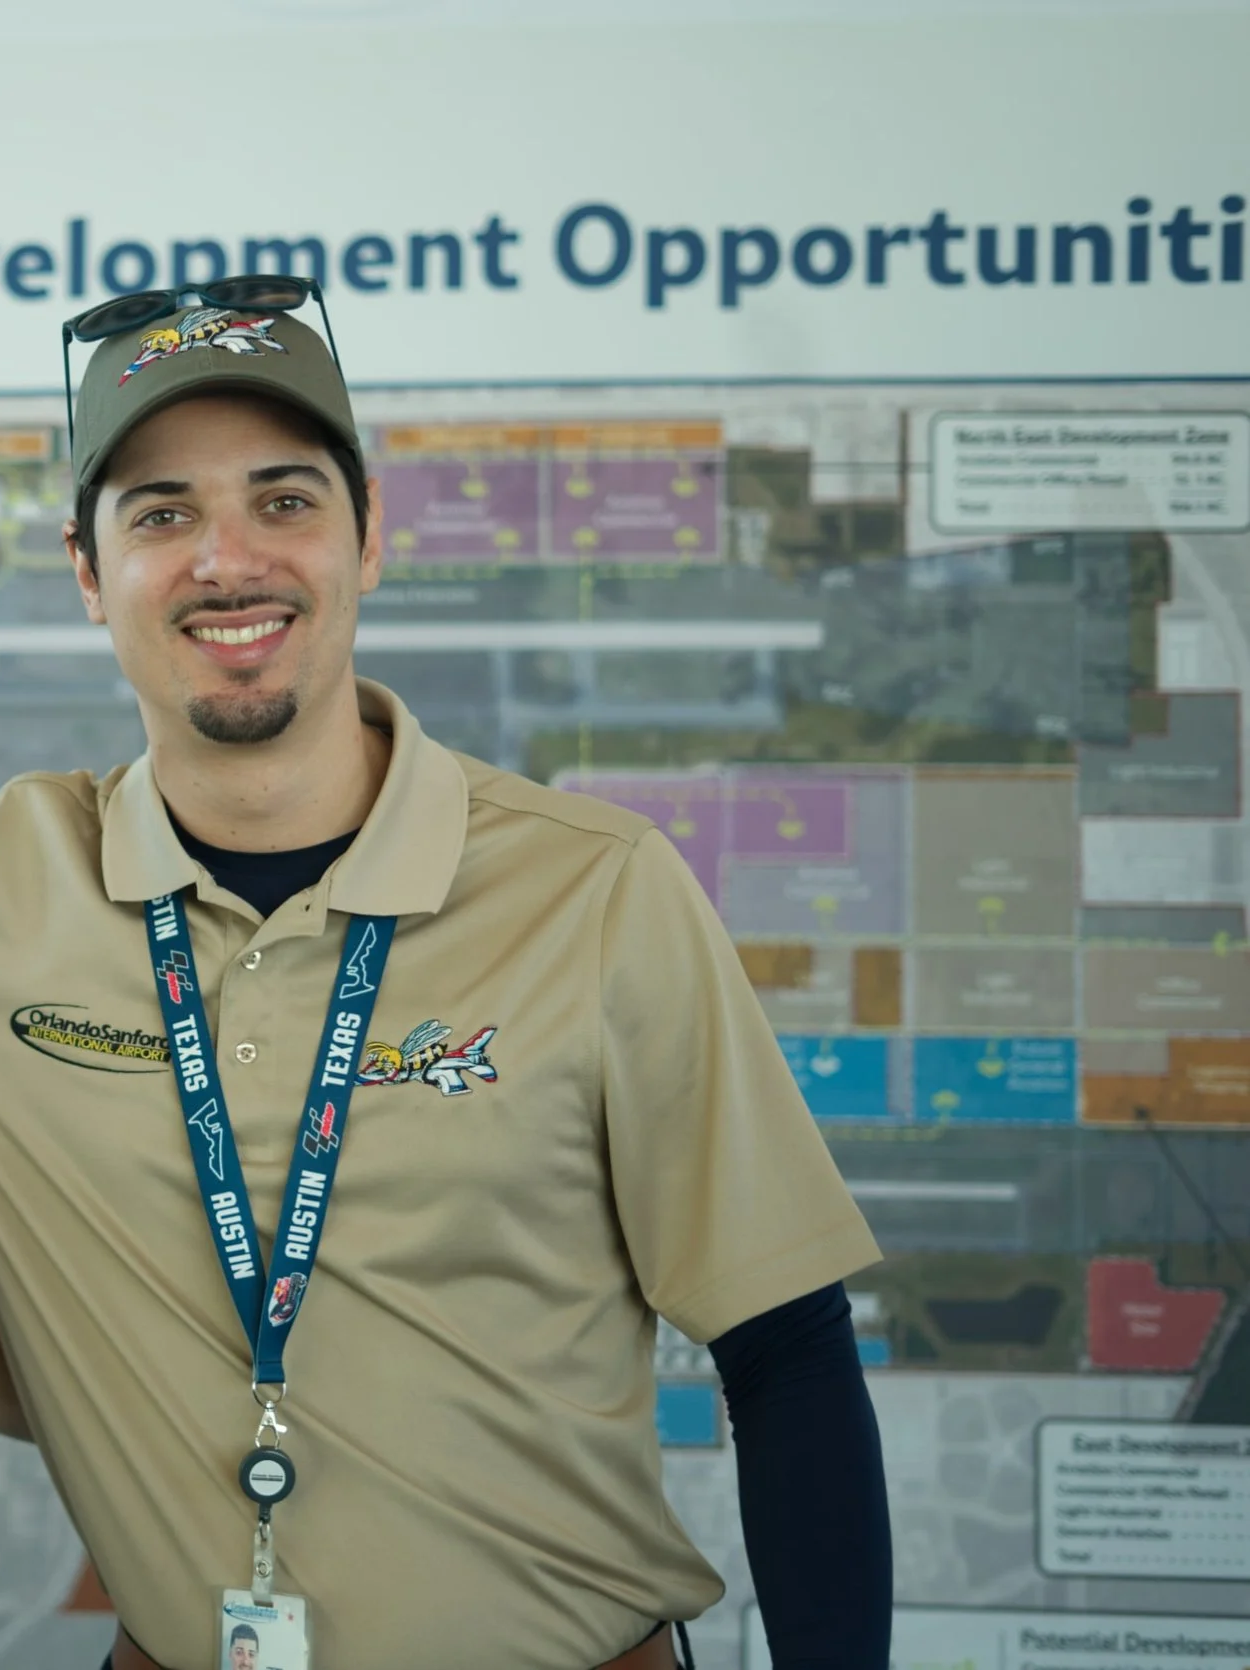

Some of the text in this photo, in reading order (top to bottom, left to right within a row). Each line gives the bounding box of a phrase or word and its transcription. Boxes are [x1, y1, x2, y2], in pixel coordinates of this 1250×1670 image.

[554, 194, 1250, 308] Opportuniti
[28, 1025, 166, 1062] INTERNATIONAL AIRPORT
[172, 1014, 209, 1092] TEXAS
[321, 1011, 362, 1087] TEXAS
[210, 1191, 256, 1280] AUSTIN
[285, 1170, 327, 1260] AUSTIN
[1020, 1628, 1118, 1652] Potential
